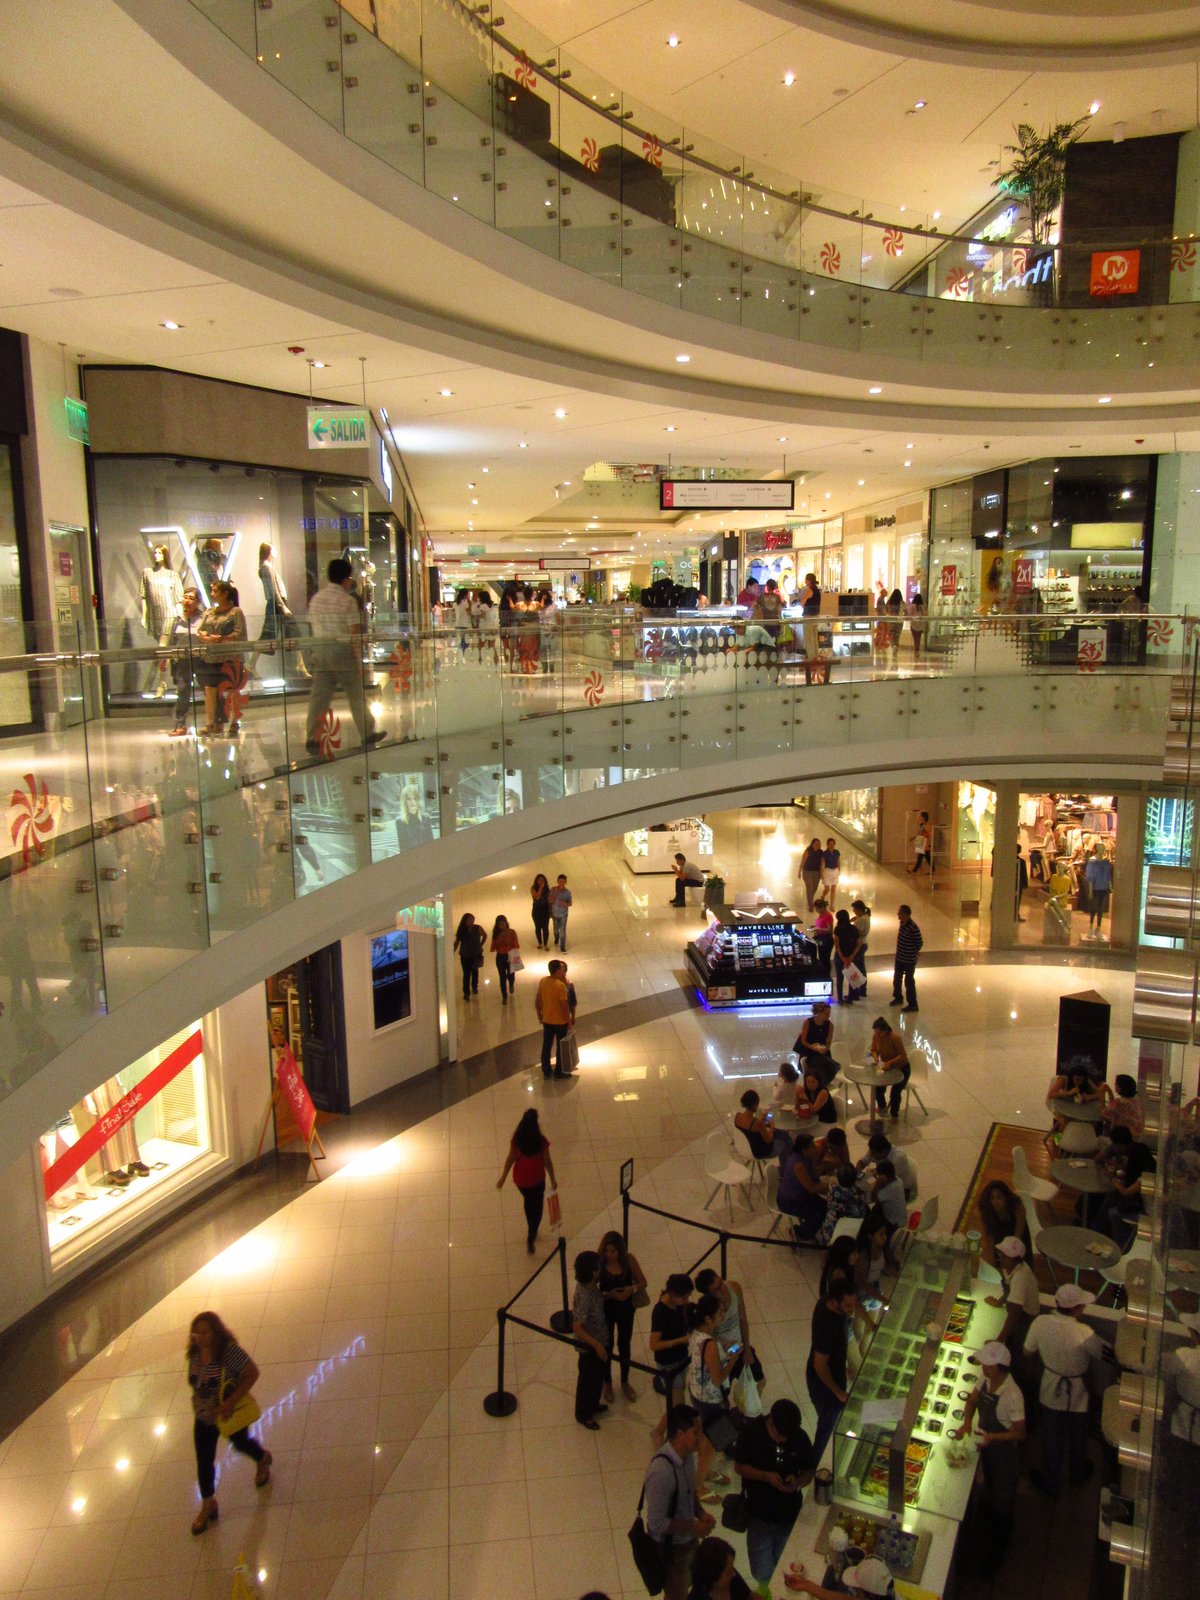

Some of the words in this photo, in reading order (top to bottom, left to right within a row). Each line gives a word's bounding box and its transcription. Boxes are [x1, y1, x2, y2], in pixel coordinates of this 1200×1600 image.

[330, 418, 366, 441] SALIDA
[666, 490, 672, 500] 2
[944, 570, 955, 585] 2x1
[1017, 564, 1032, 583] 2x1
